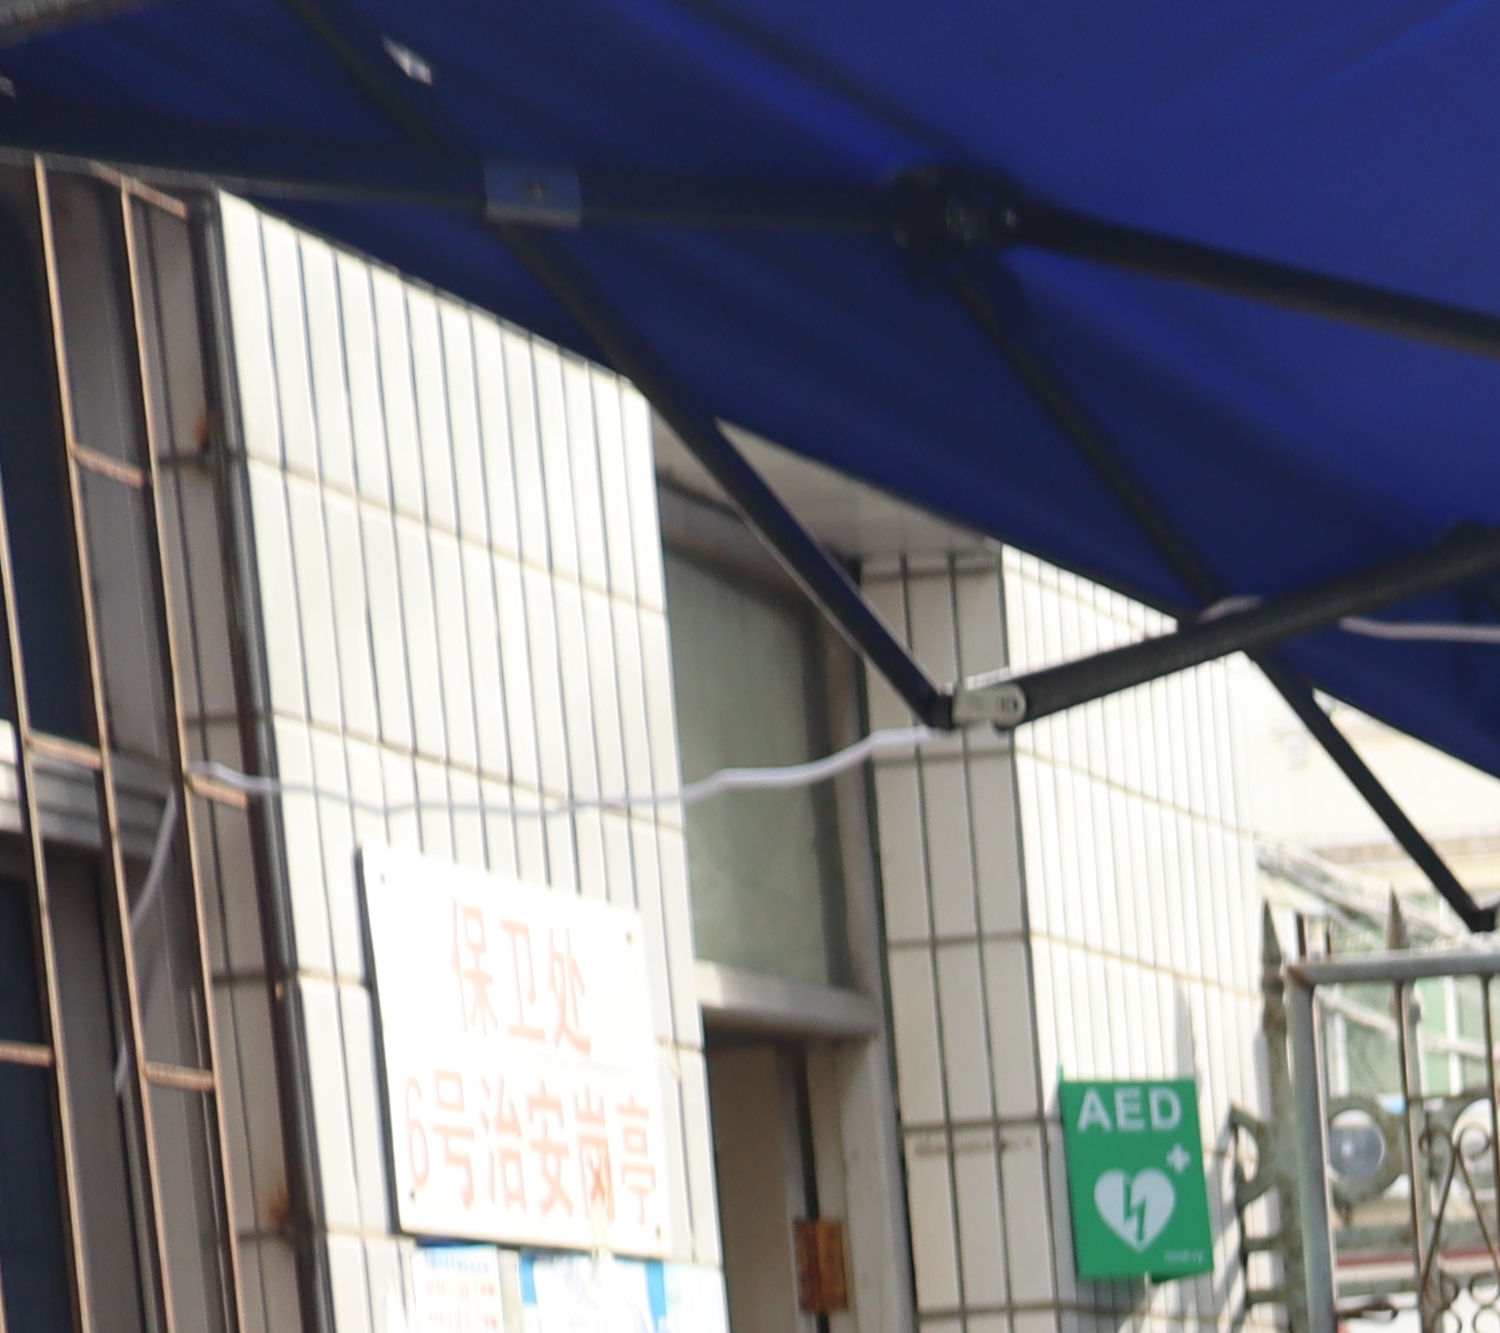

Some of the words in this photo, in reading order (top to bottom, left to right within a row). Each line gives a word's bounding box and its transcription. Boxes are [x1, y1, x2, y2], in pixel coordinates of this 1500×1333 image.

[450, 897, 591, 1055] 保卫处
[405, 1068, 657, 1227] 6号治安岗亭
[1077, 1086, 1182, 1132] AED
